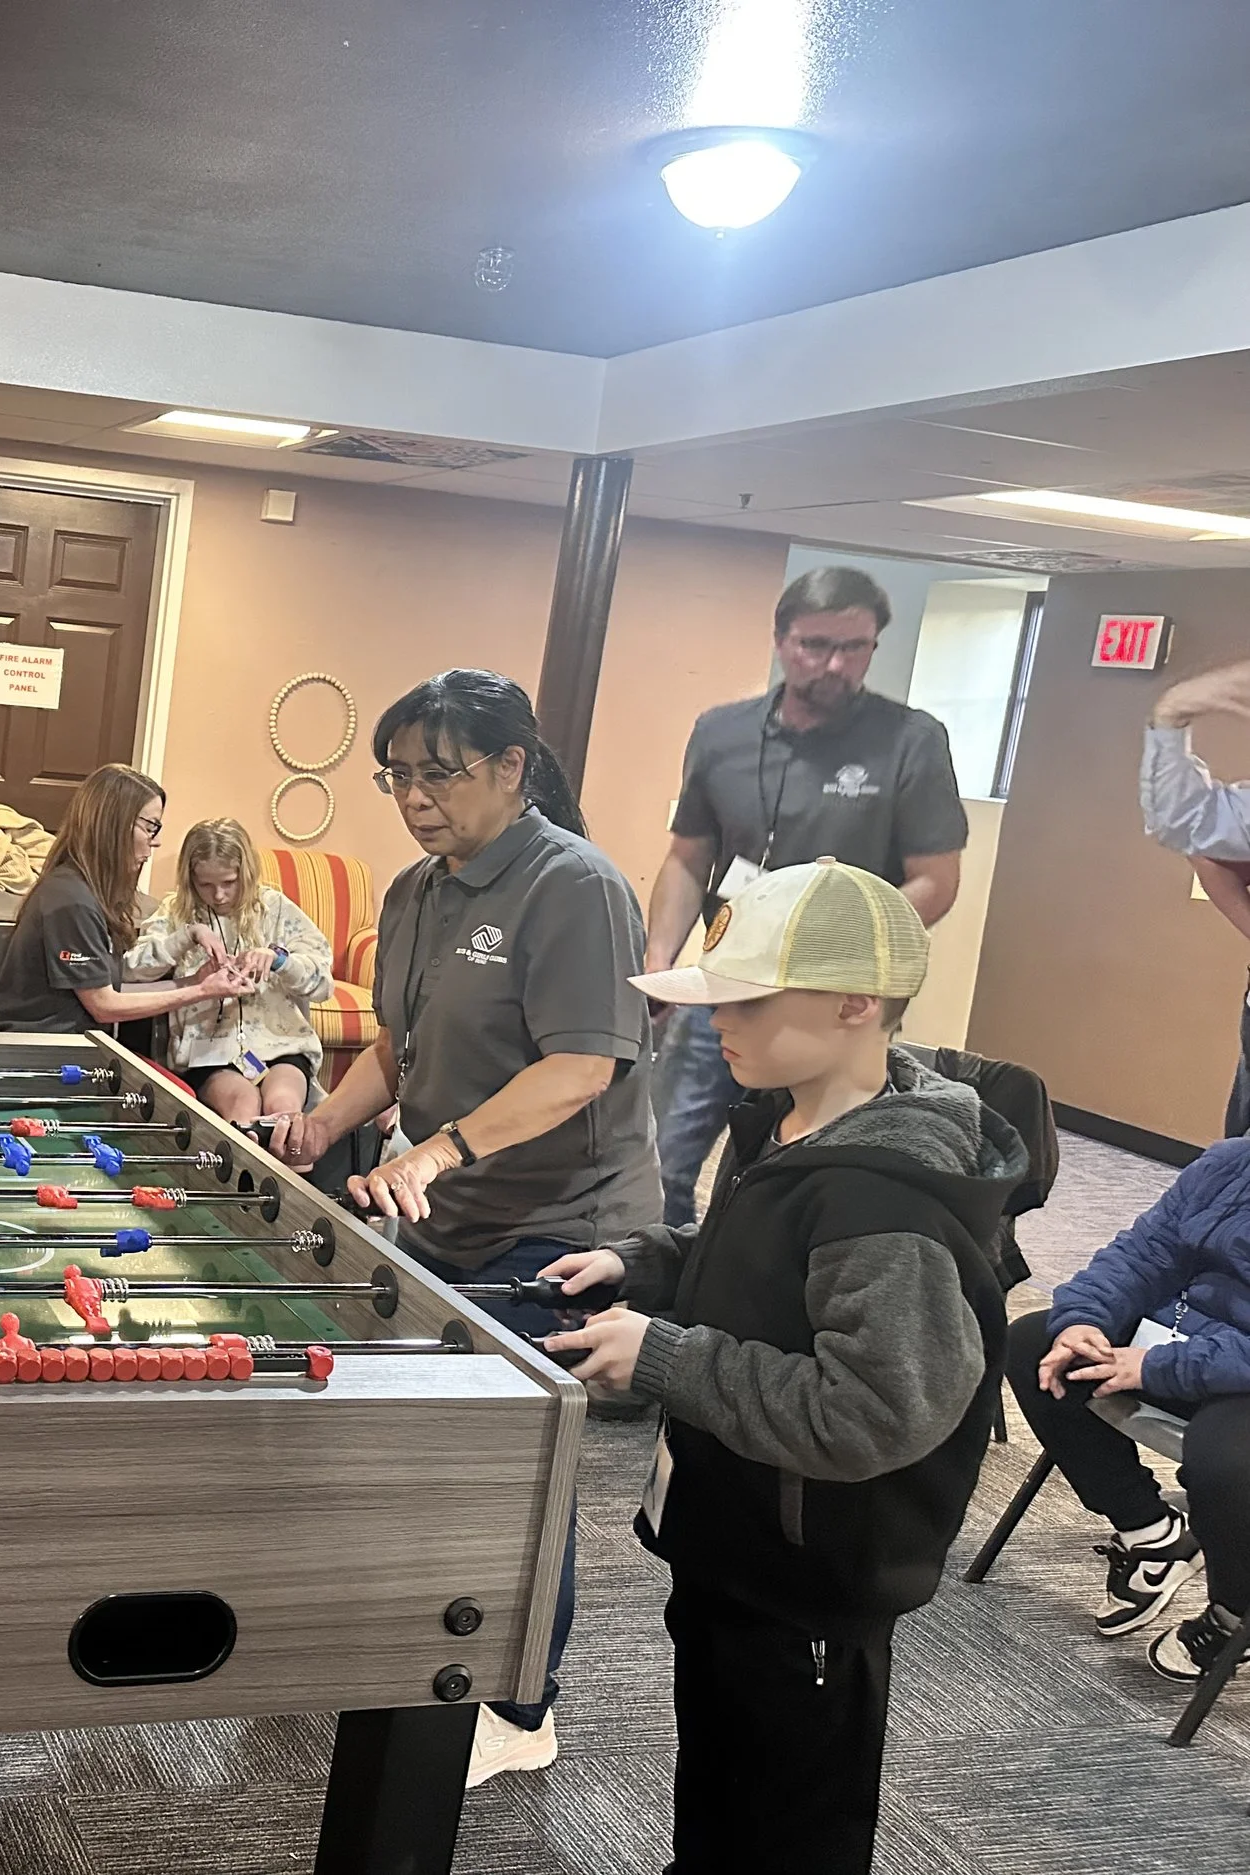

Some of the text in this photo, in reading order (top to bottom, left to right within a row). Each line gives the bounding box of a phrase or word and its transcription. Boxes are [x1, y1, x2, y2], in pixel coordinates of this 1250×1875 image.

[1100, 620, 1155, 663] EXIT
[0, 654, 52, 665] FIRE ALARM
[3, 669, 45, 679] CONTROL
[9, 684, 38, 693] PANEL
